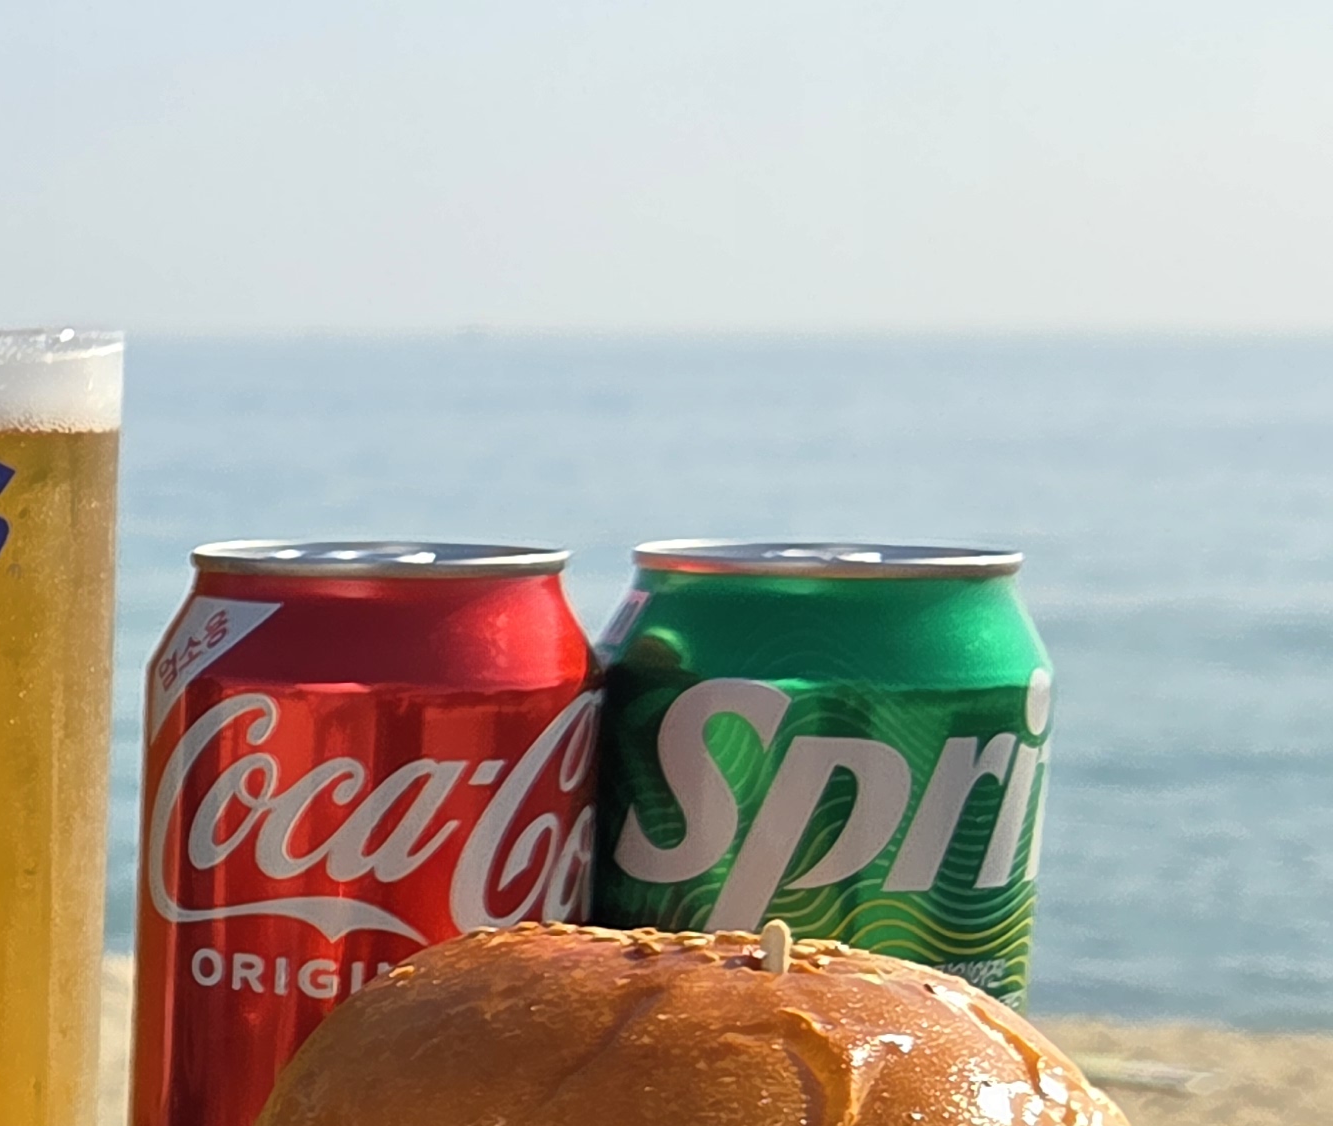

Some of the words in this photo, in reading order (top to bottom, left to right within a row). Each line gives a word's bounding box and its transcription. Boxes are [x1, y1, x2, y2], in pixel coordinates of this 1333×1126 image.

[158, 610, 229, 692] 업소용
[148, 690, 599, 946] Coca-Co
[613, 667, 1049, 932] Spri
[192, 948, 395, 999] ORIGI
